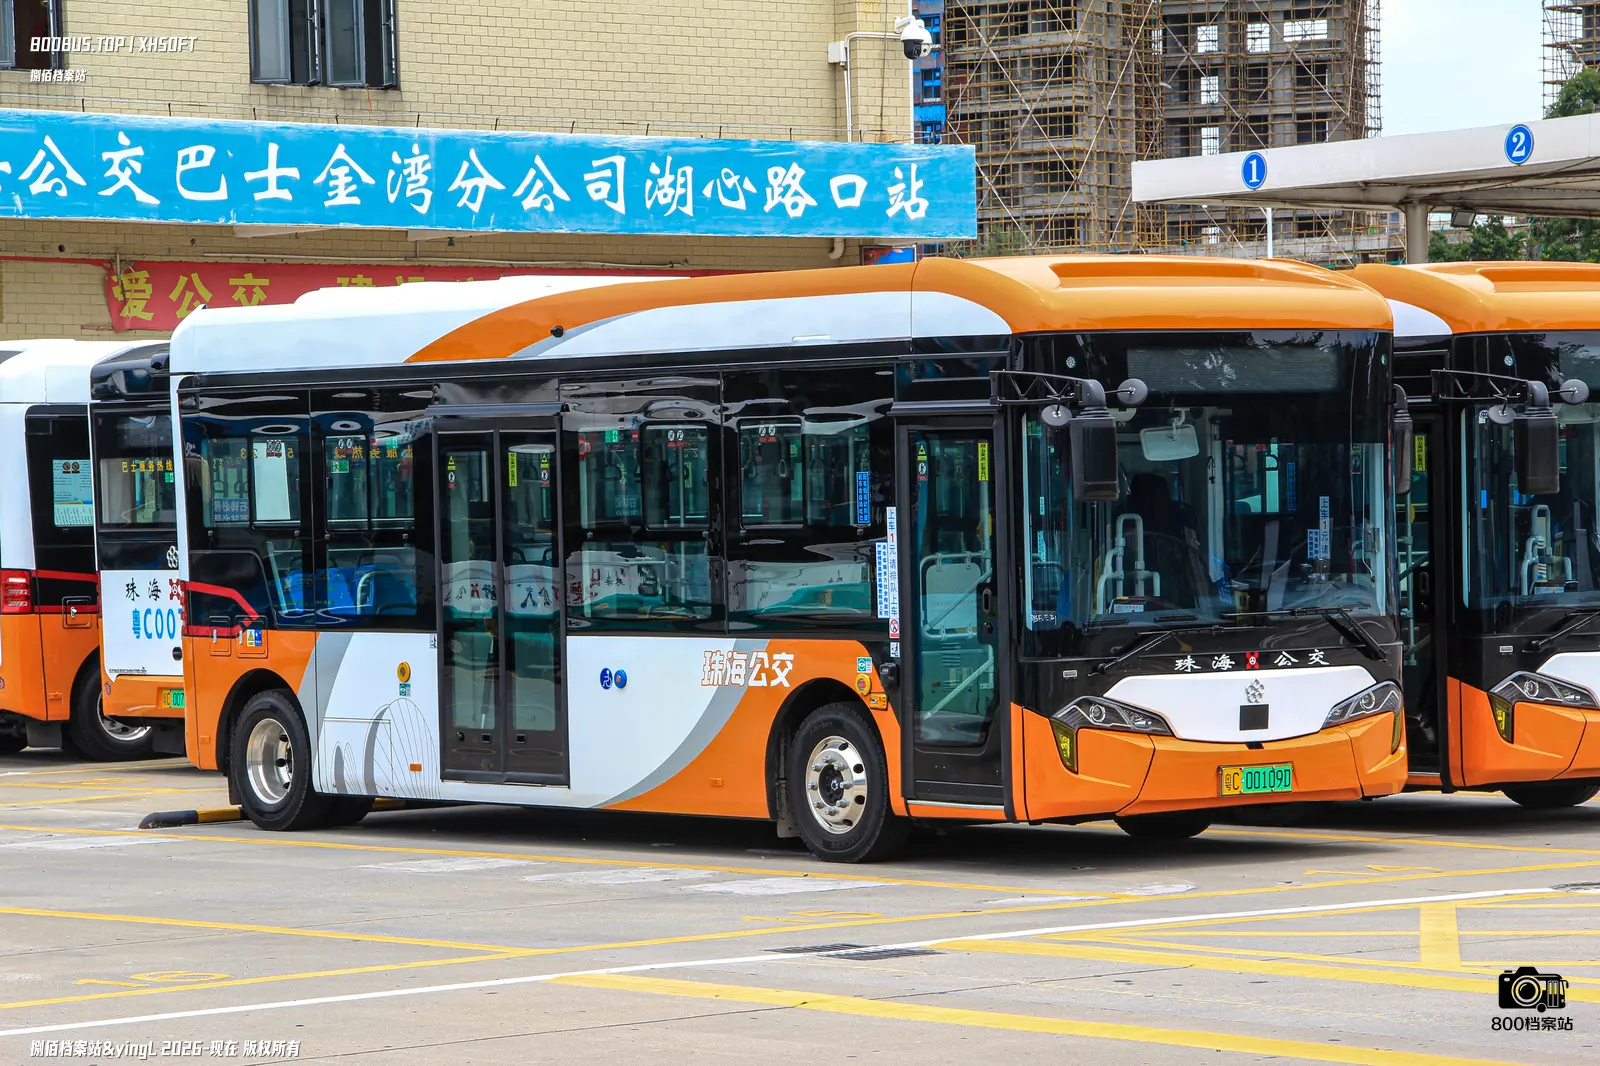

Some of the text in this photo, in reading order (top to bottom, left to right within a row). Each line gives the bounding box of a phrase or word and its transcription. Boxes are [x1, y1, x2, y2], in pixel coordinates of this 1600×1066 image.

[1511, 131, 1527, 158] 2
[0, 131, 930, 220] 公交巴士金湾分公司湖心路口站
[1248, 158, 1260, 183] 1
[125, 577, 162, 602] 珠海
[132, 608, 182, 639] 粤C00
[701, 649, 795, 688] 珠海公交
[1174, 648, 1330, 673] 珠海 公交
